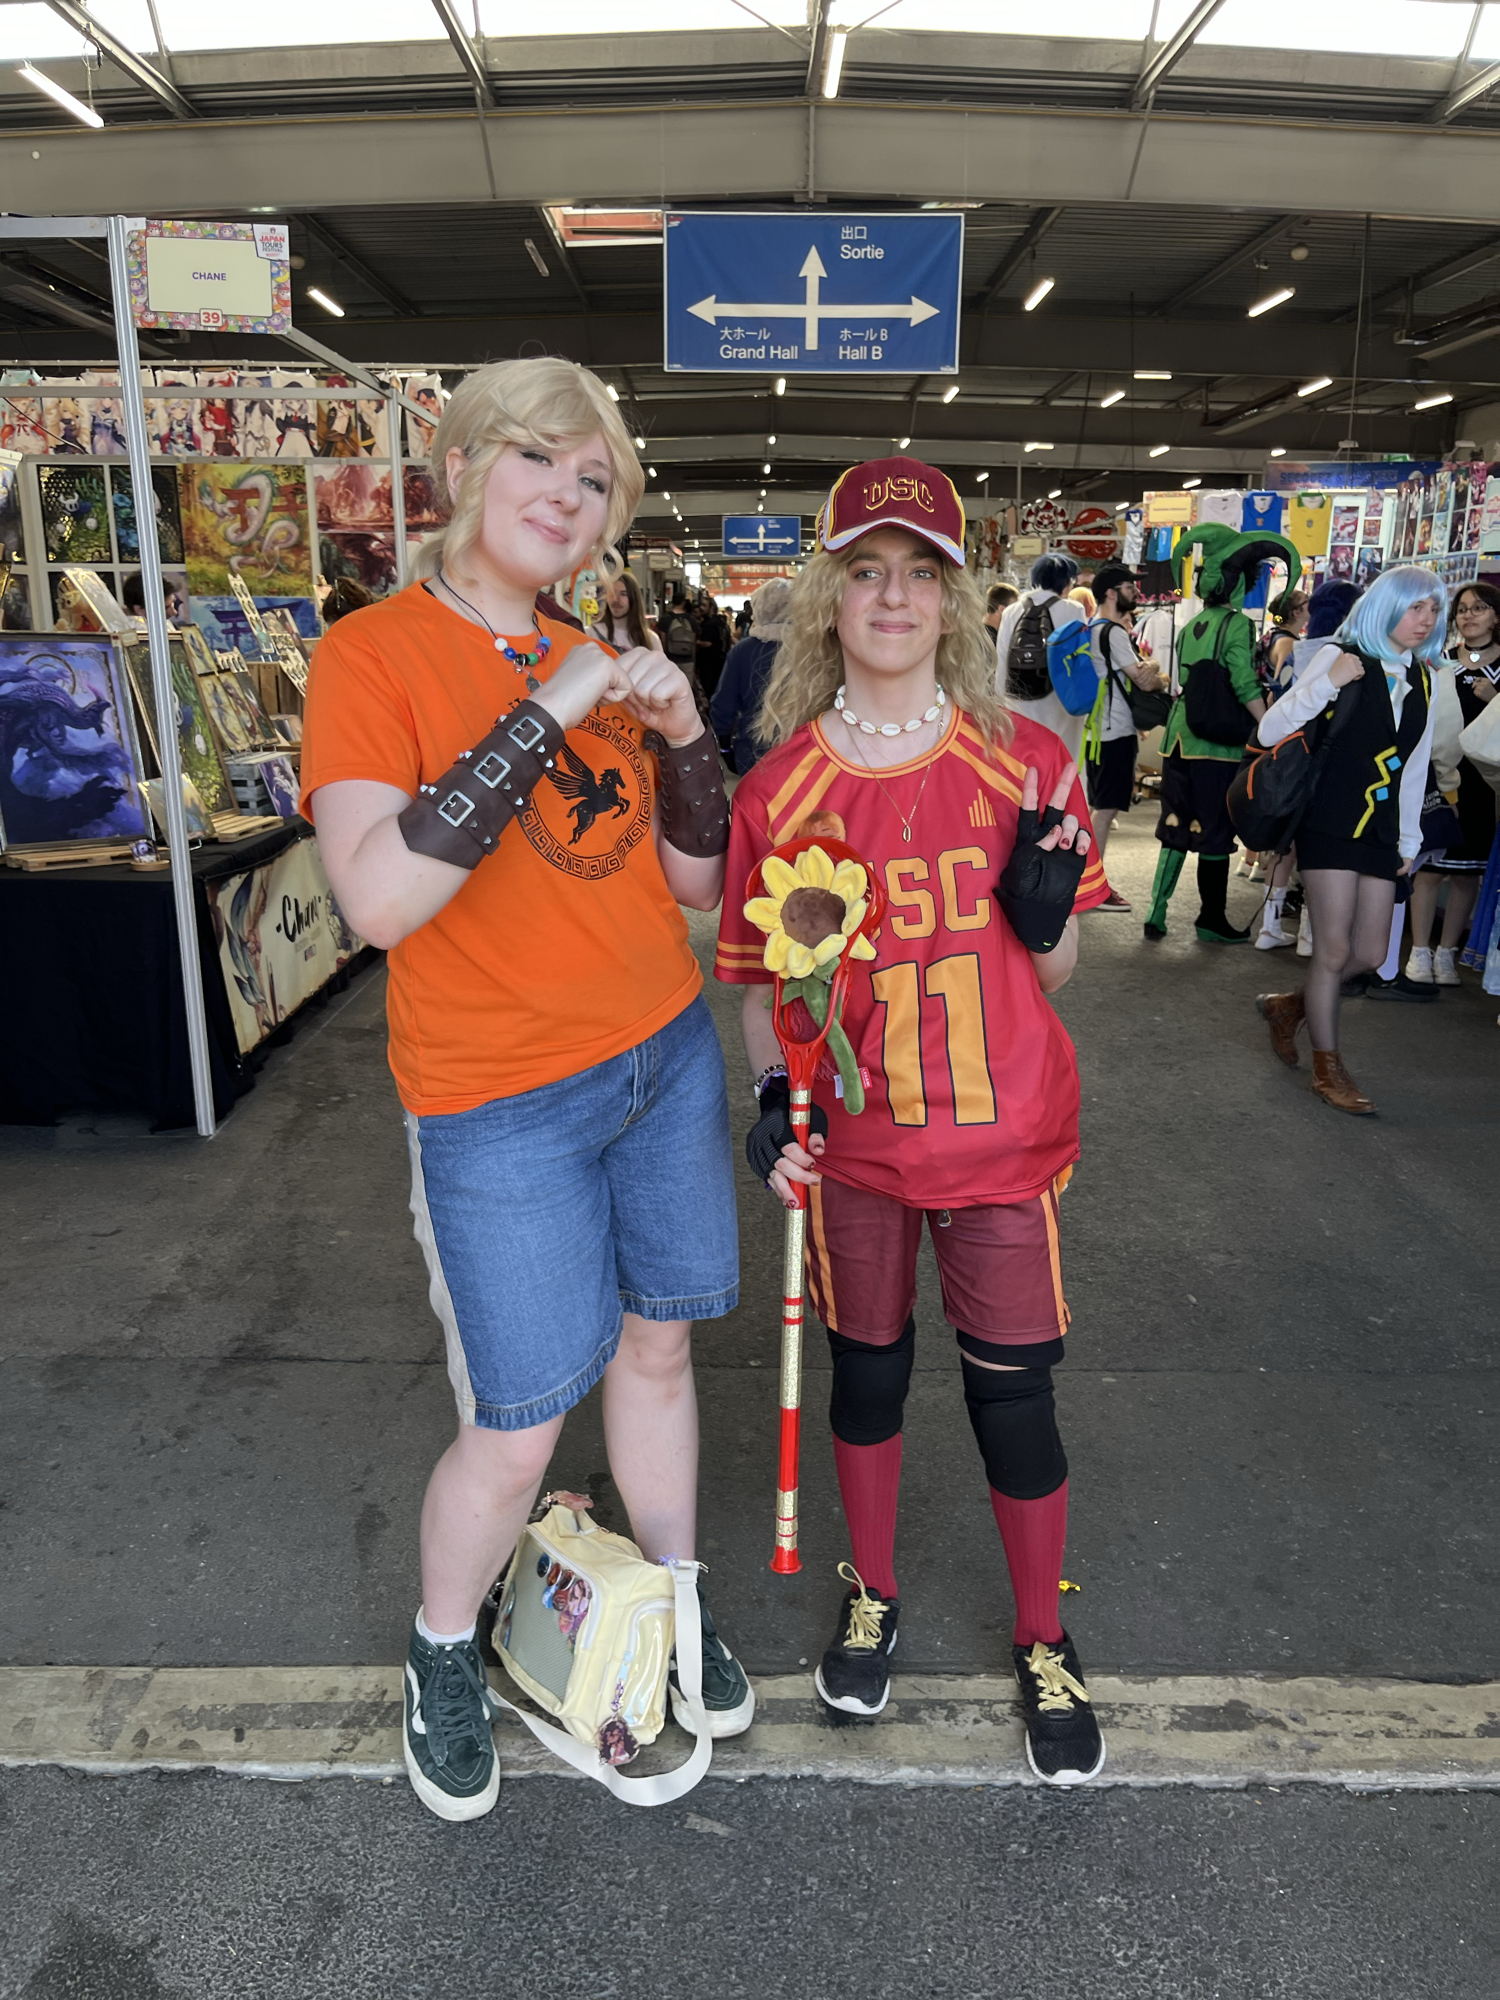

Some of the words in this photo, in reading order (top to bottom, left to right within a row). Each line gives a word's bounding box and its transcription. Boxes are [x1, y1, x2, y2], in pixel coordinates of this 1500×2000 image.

[259, 235, 285, 243] JAPAN
[841, 225, 867, 240] 出口
[840, 244, 885, 260] Sortie
[192, 271, 227, 281] CHANE
[202, 311, 220, 324] 39
[720, 326, 771, 341] 大ホール
[720, 344, 766, 360] Grand
[770, 344, 798, 360] Hall
[839, 345, 868, 360] Hall
[872, 346, 883, 360] B
[863, 474, 935, 513] USC
[866, 845, 992, 941] SC
[870, 952, 998, 1128] 11
